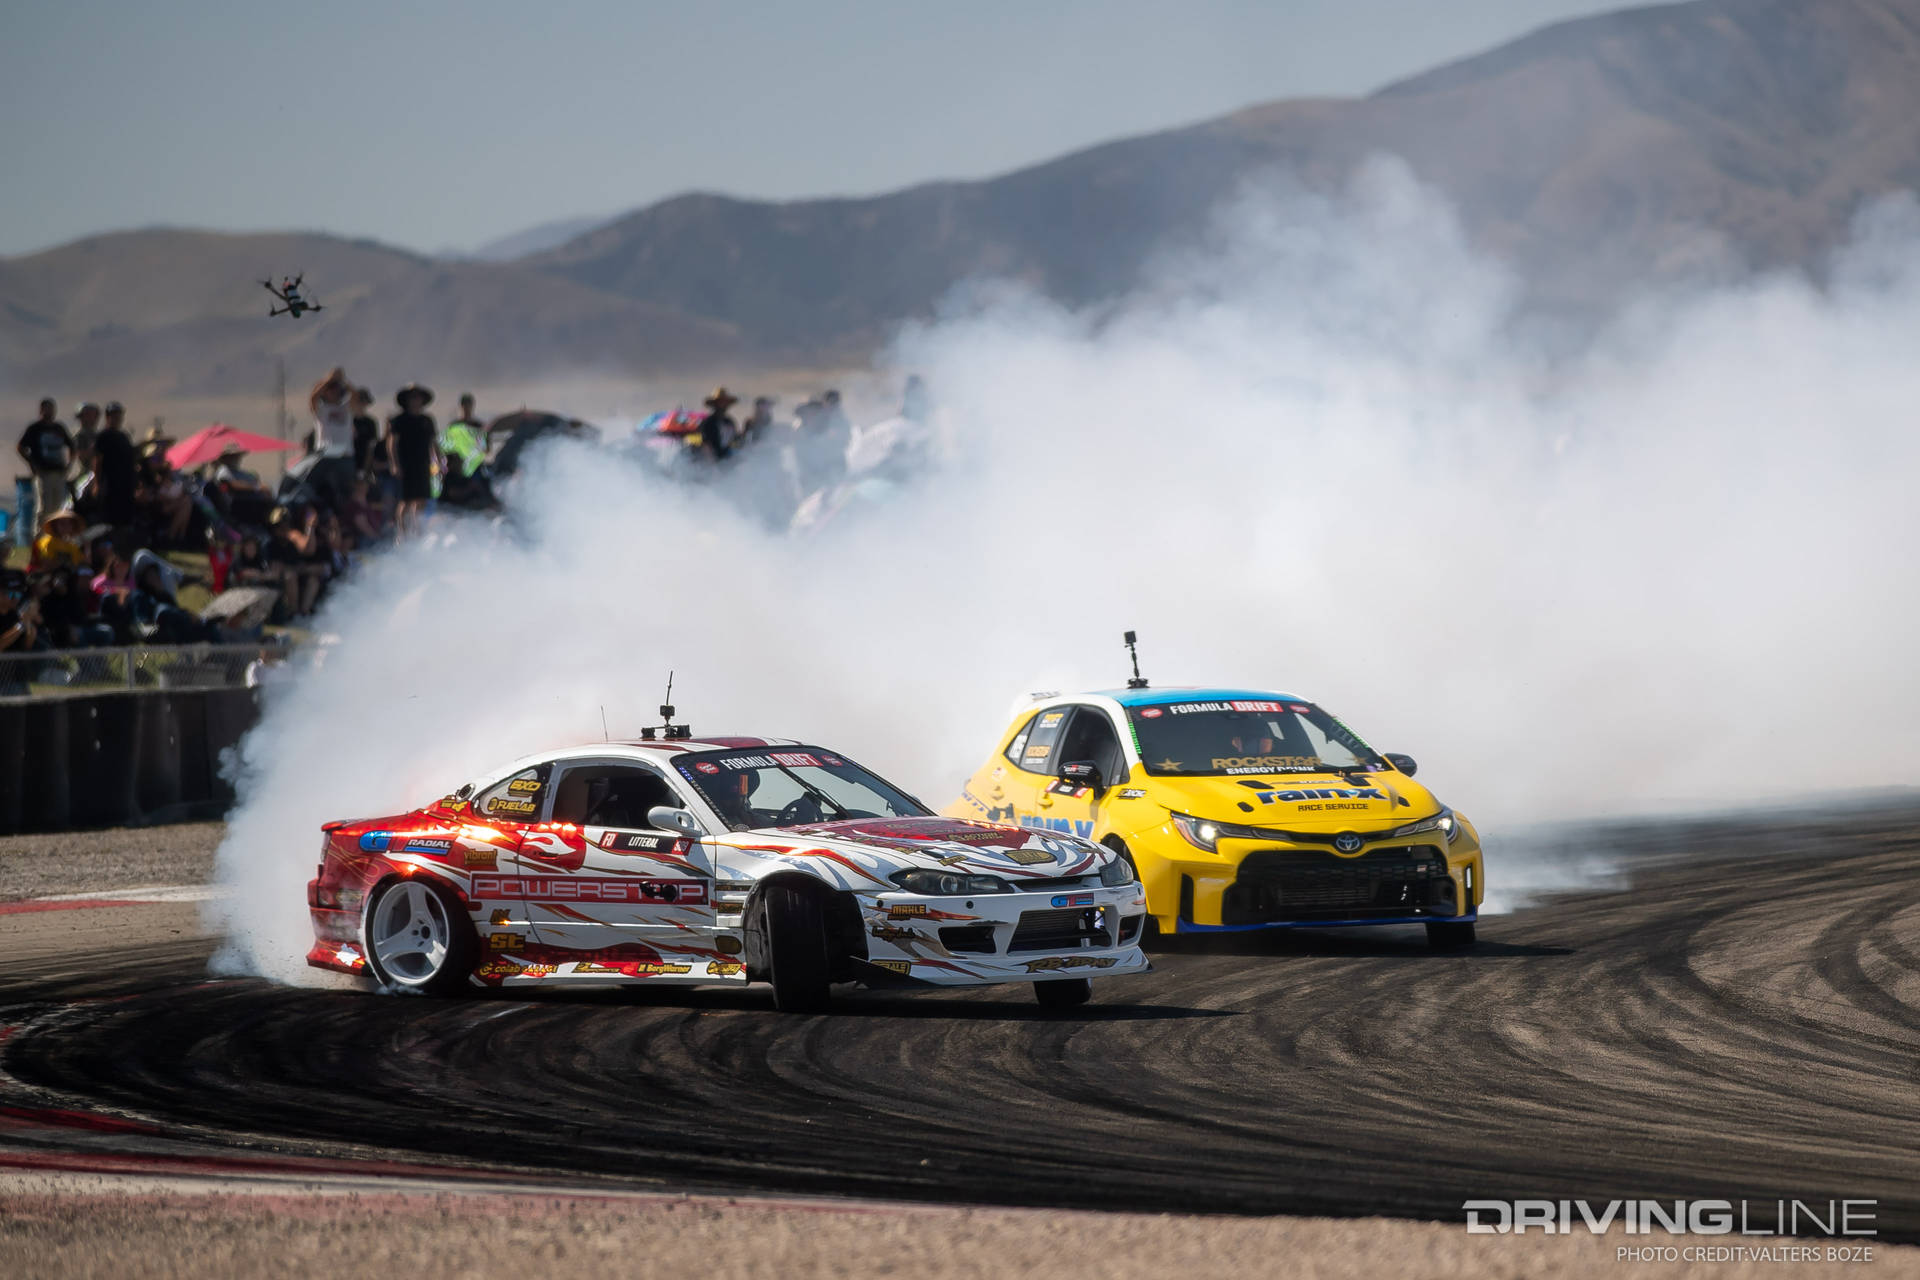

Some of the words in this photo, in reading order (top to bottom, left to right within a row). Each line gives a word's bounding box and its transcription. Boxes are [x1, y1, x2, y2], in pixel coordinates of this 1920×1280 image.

[1170, 702, 1232, 715] FORMULA
[1233, 701, 1279, 712] DRIFT
[720, 756, 779, 770] FORMULA
[776, 753, 818, 766] DRIFT
[1211, 756, 1322, 769] ROCKSTAR
[1226, 766, 1275, 775] ENERGY
[497, 801, 536, 812] FUELAB
[1298, 804, 1323, 812] RACE
[1326, 802, 1369, 811] SERVICE
[408, 839, 451, 849] RADIAL
[628, 836, 659, 848] LITTERAL
[893, 905, 925, 914] MAHLE
